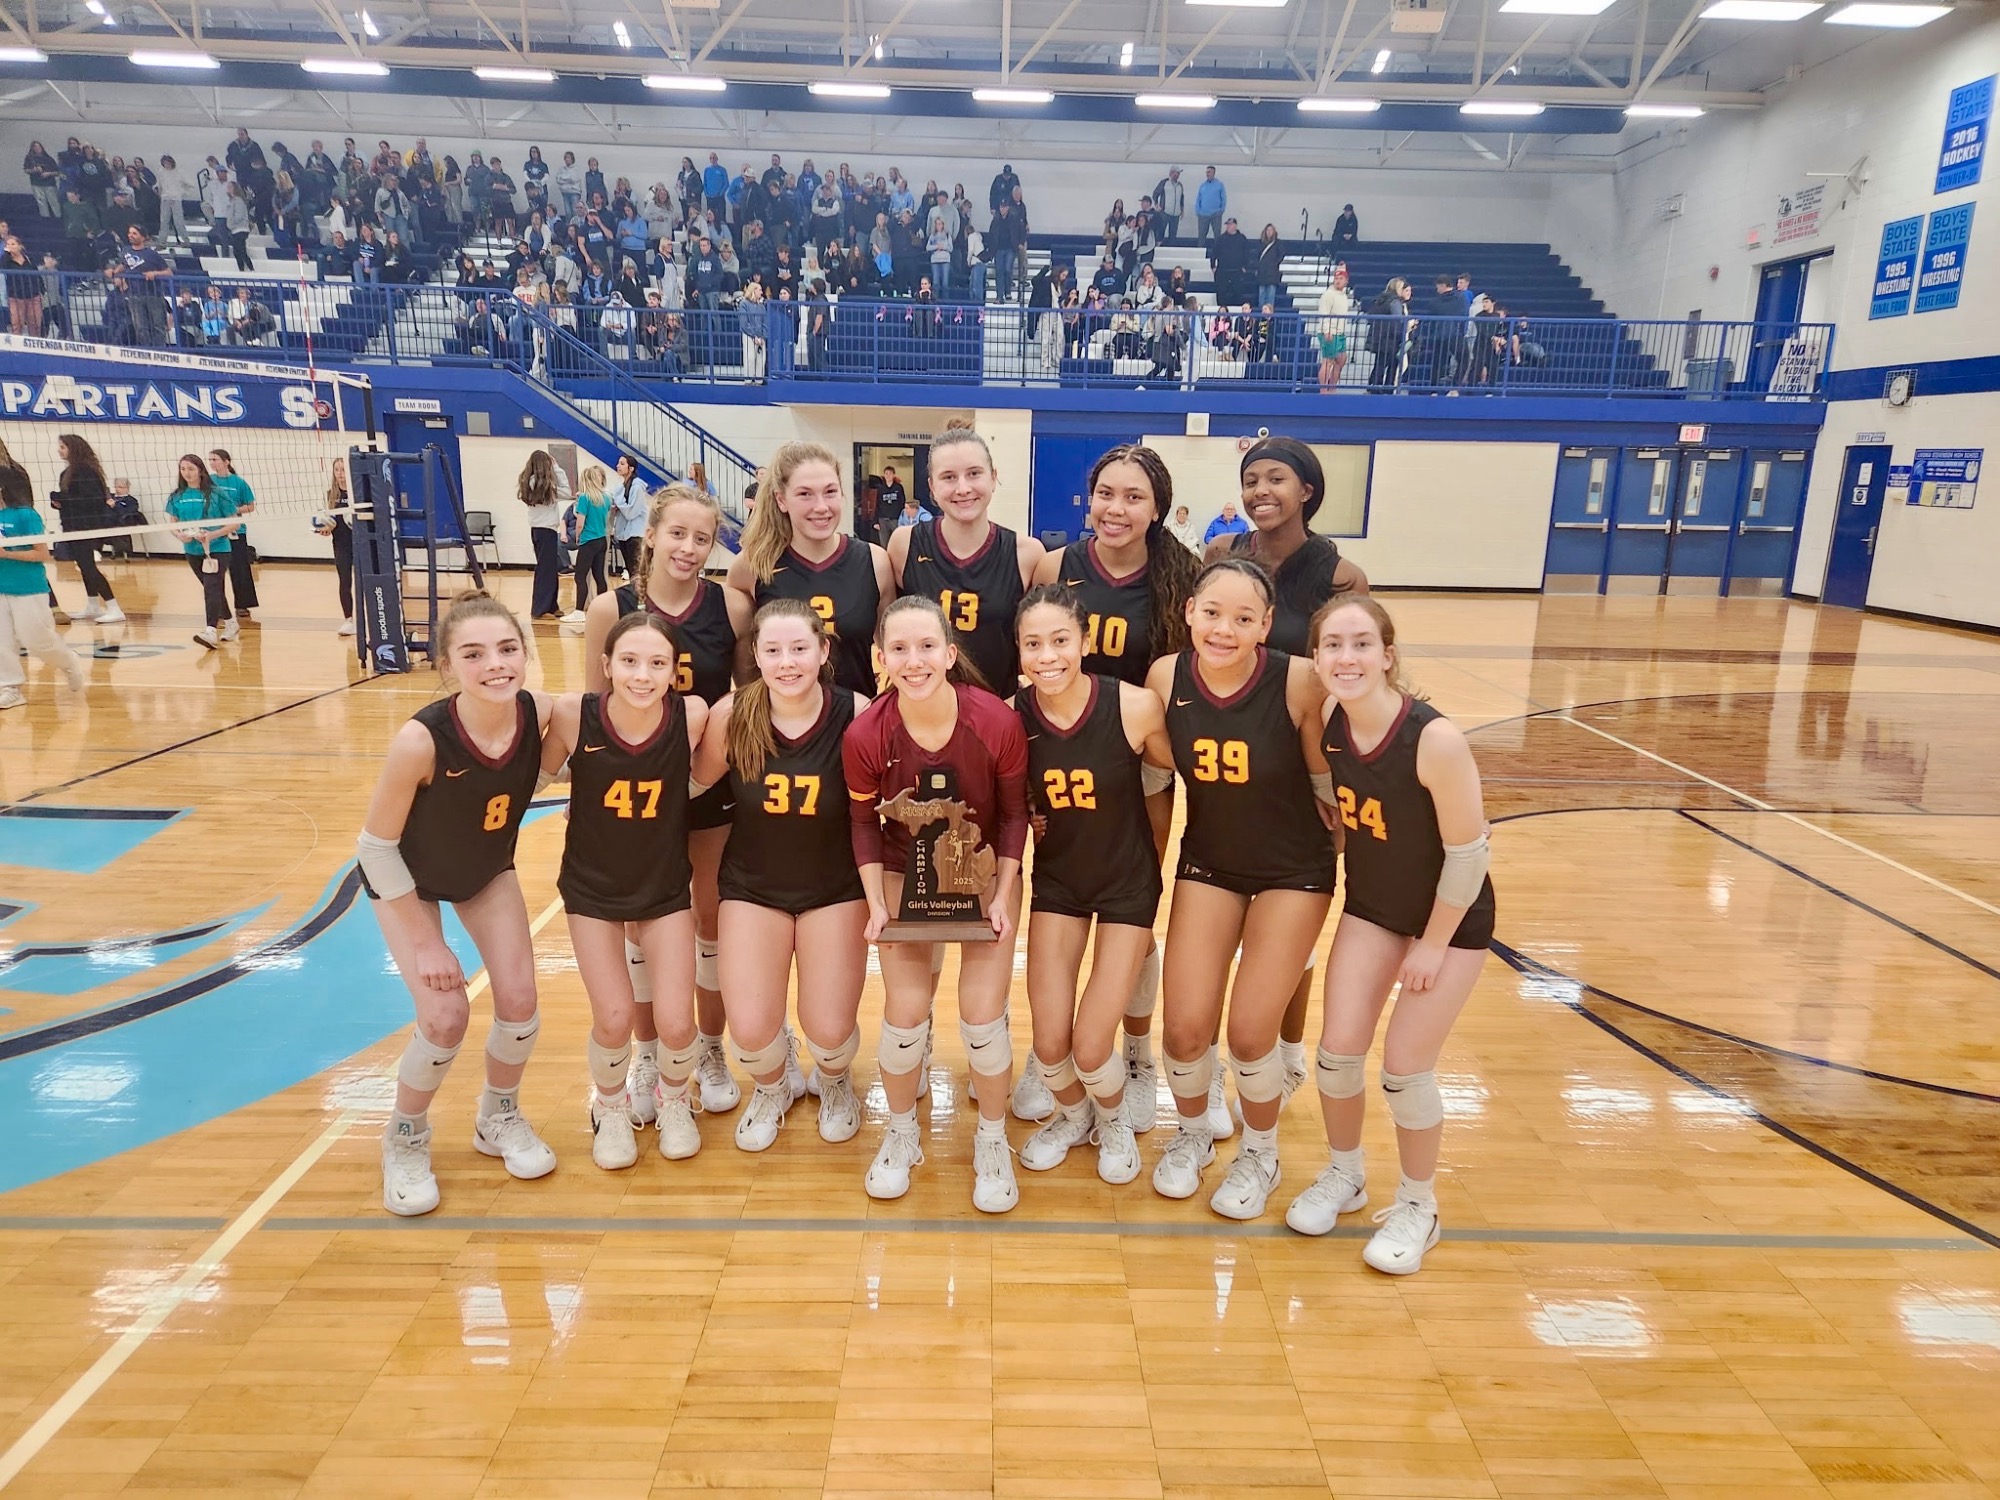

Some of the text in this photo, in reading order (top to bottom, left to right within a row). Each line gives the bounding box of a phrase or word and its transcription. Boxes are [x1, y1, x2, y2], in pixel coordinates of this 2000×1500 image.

[1955, 82, 1991, 107] BOYS
[1950, 100, 1990, 124] STATE
[1951, 126, 1980, 148] 2016
[1942, 141, 1983, 167] HOCKEY
[1934, 209, 1968, 230] BOYS
[1886, 221, 1918, 240] BOYS
[1929, 225, 1967, 246] STATE
[1883, 236, 1917, 256] STATE
[1885, 261, 1907, 278] 1995
[1931, 251, 1957, 269] 1996
[1875, 277, 1911, 296] WRESTLING
[1921, 267, 1961, 288] WRESTLING
[1872, 299, 1907, 314] FINAL FOUR
[1917, 290, 1957, 308] STATE FINALS
[23, 337, 96, 354] STEVENSON SPARTANS
[1788, 344, 1806, 356] NO
[1780, 357, 1819, 366] STANDING
[1784, 366, 1810, 375] ALONG
[1787, 375, 1801, 384] THE
[398, 401, 437, 410] TEAM ROOM
[898, 432, 919, 440] TRAINING
[1685, 428, 1702, 440] EXIT
[375, 587, 389, 640] sports imports
[810, 596, 834, 634] 2
[940, 589, 979, 632] 13
[1088, 613, 1128, 657] 10
[1193, 738, 1250, 784] 39
[603, 779, 662, 819] 47
[763, 773, 821, 815] 37
[1044, 768, 1096, 810] 22
[483, 793, 511, 832] 8
[1336, 785, 1388, 841] 24
[916, 839, 926, 895] CHAMPION
[953, 877, 974, 885] 2025
[908, 900, 973, 911] Girls Volleyball
